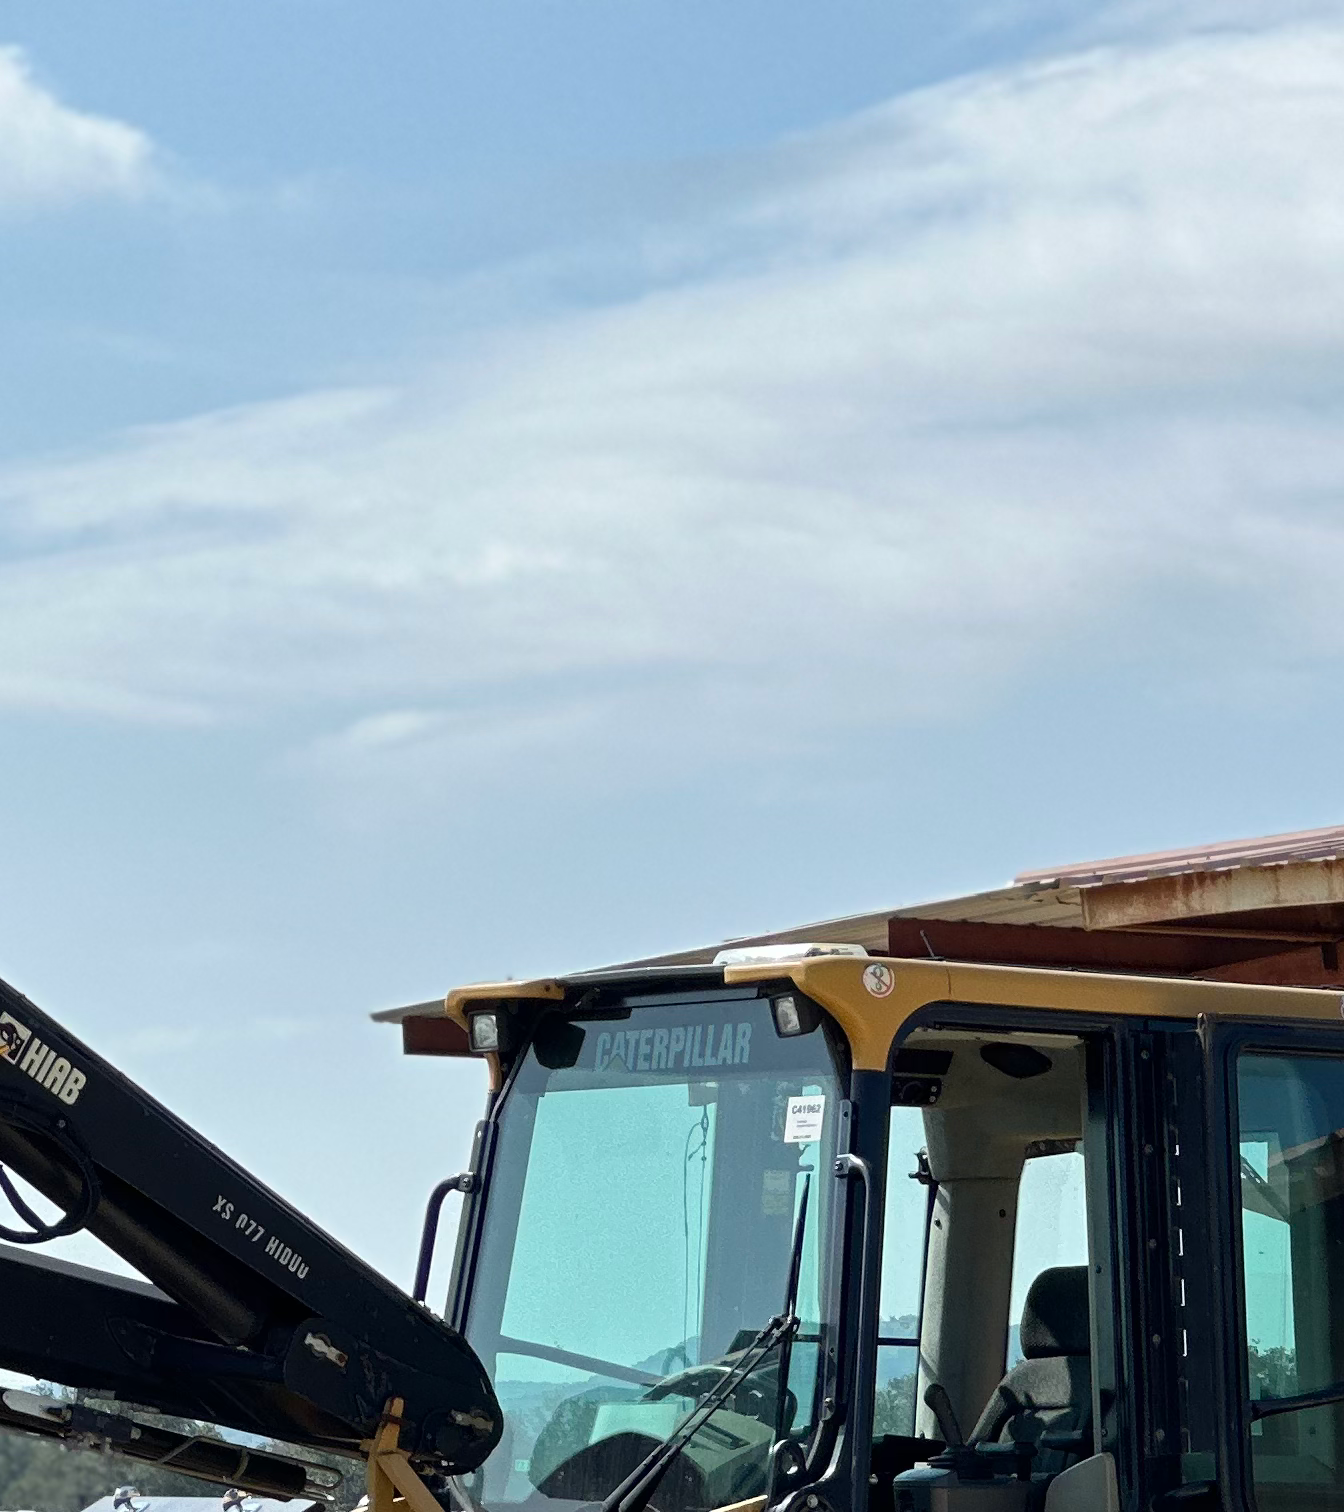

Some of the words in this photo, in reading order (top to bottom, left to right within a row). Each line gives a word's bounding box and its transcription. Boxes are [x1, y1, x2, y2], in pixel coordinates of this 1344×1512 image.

[19, 1037, 87, 1105] HIAB
[595, 1022, 752, 1072] CATERPILLAR
[212, 1194, 235, 1220] XS
